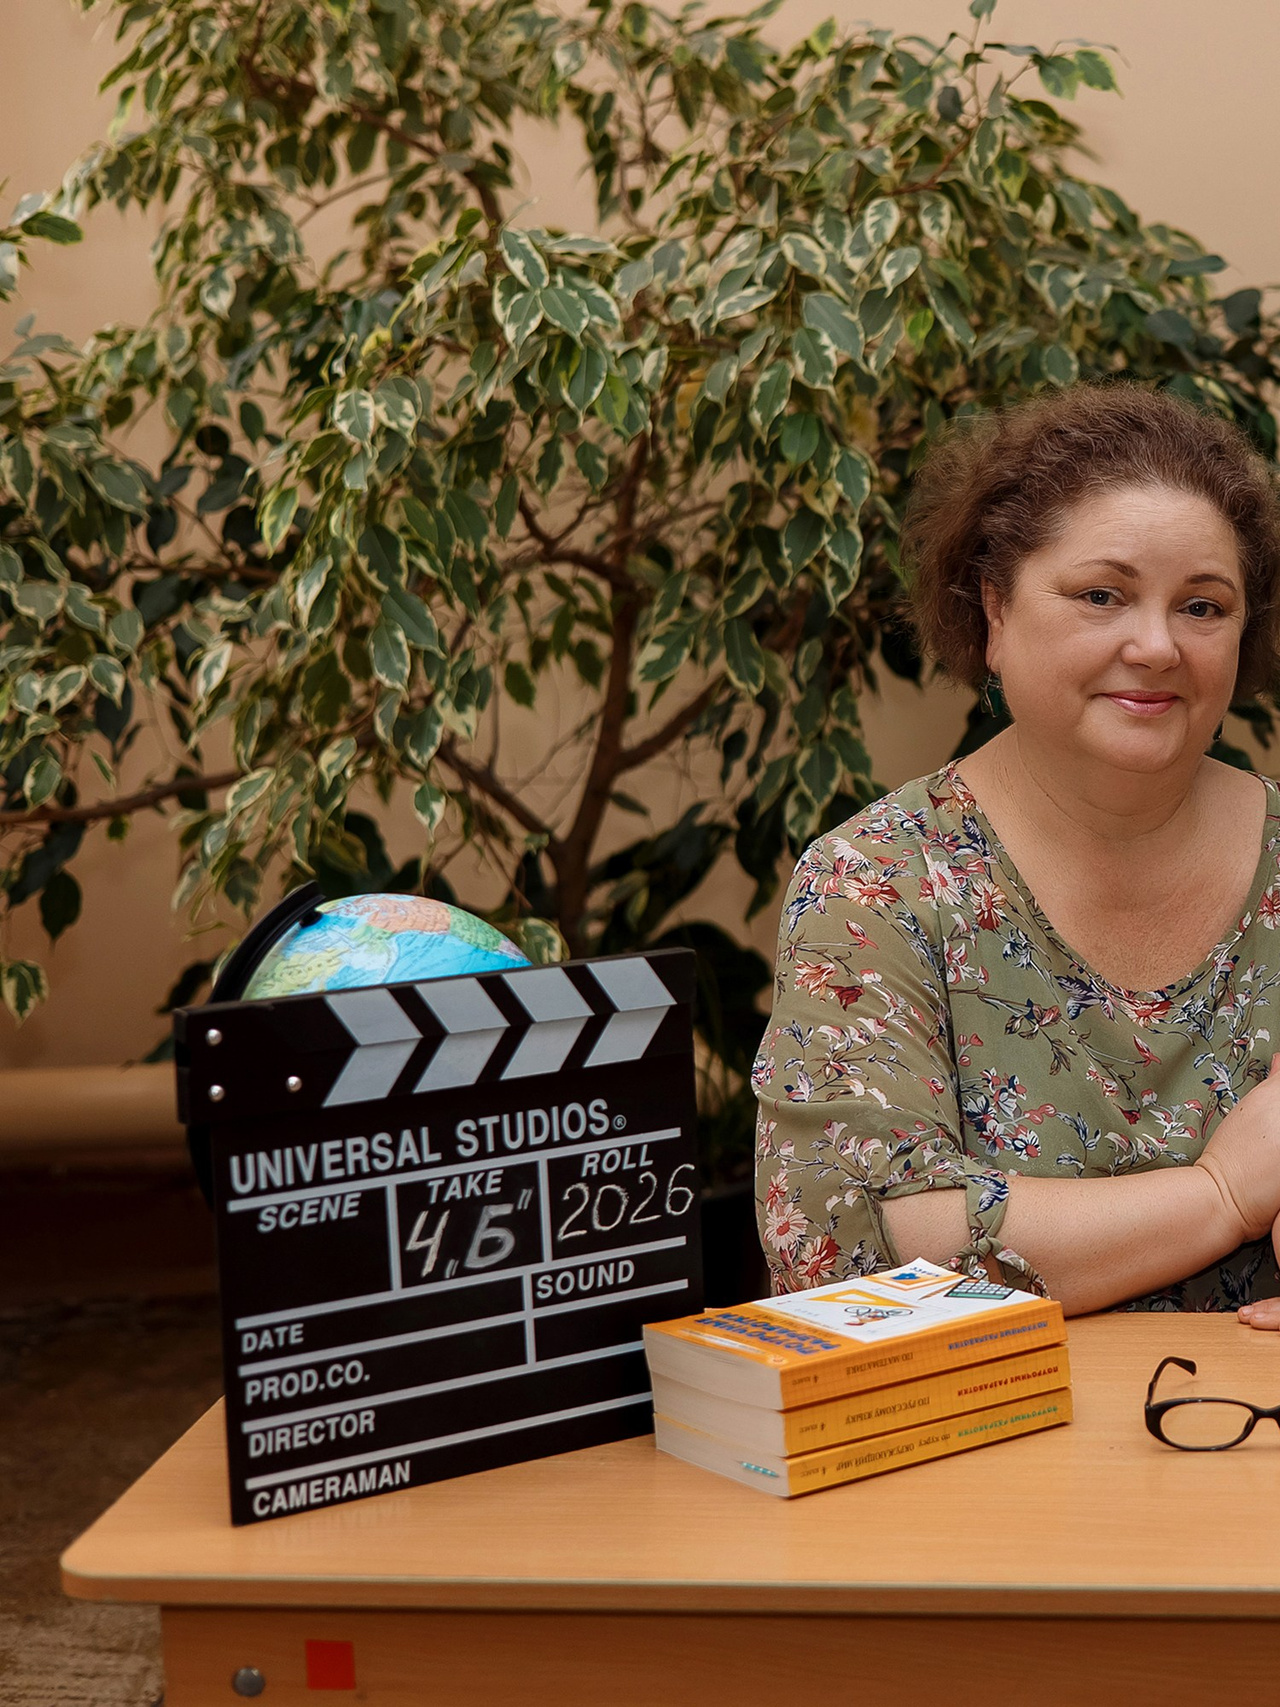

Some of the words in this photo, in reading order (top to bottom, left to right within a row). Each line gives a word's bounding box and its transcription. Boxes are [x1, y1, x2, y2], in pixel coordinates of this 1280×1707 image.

[229, 1126, 442, 1194] UNIVERSAL
[581, 1144, 653, 1177] ROLL
[428, 1169, 503, 1204] TAKE
[557, 1163, 696, 1242] 2026
[257, 1192, 362, 1233] SCENE
[536, 1259, 636, 1299] SOUND
[242, 1323, 304, 1354] DATE
[245, 1359, 371, 1405] PROD.CO.
[958, 1378, 1009, 1397] РАЗРАБОТКИ
[1010, 1366, 1059, 1384] ПОУРОЧНЫЕ
[249, 1409, 376, 1458] DIRECTOR
[252, 1460, 411, 1516] CAMERAMAN
